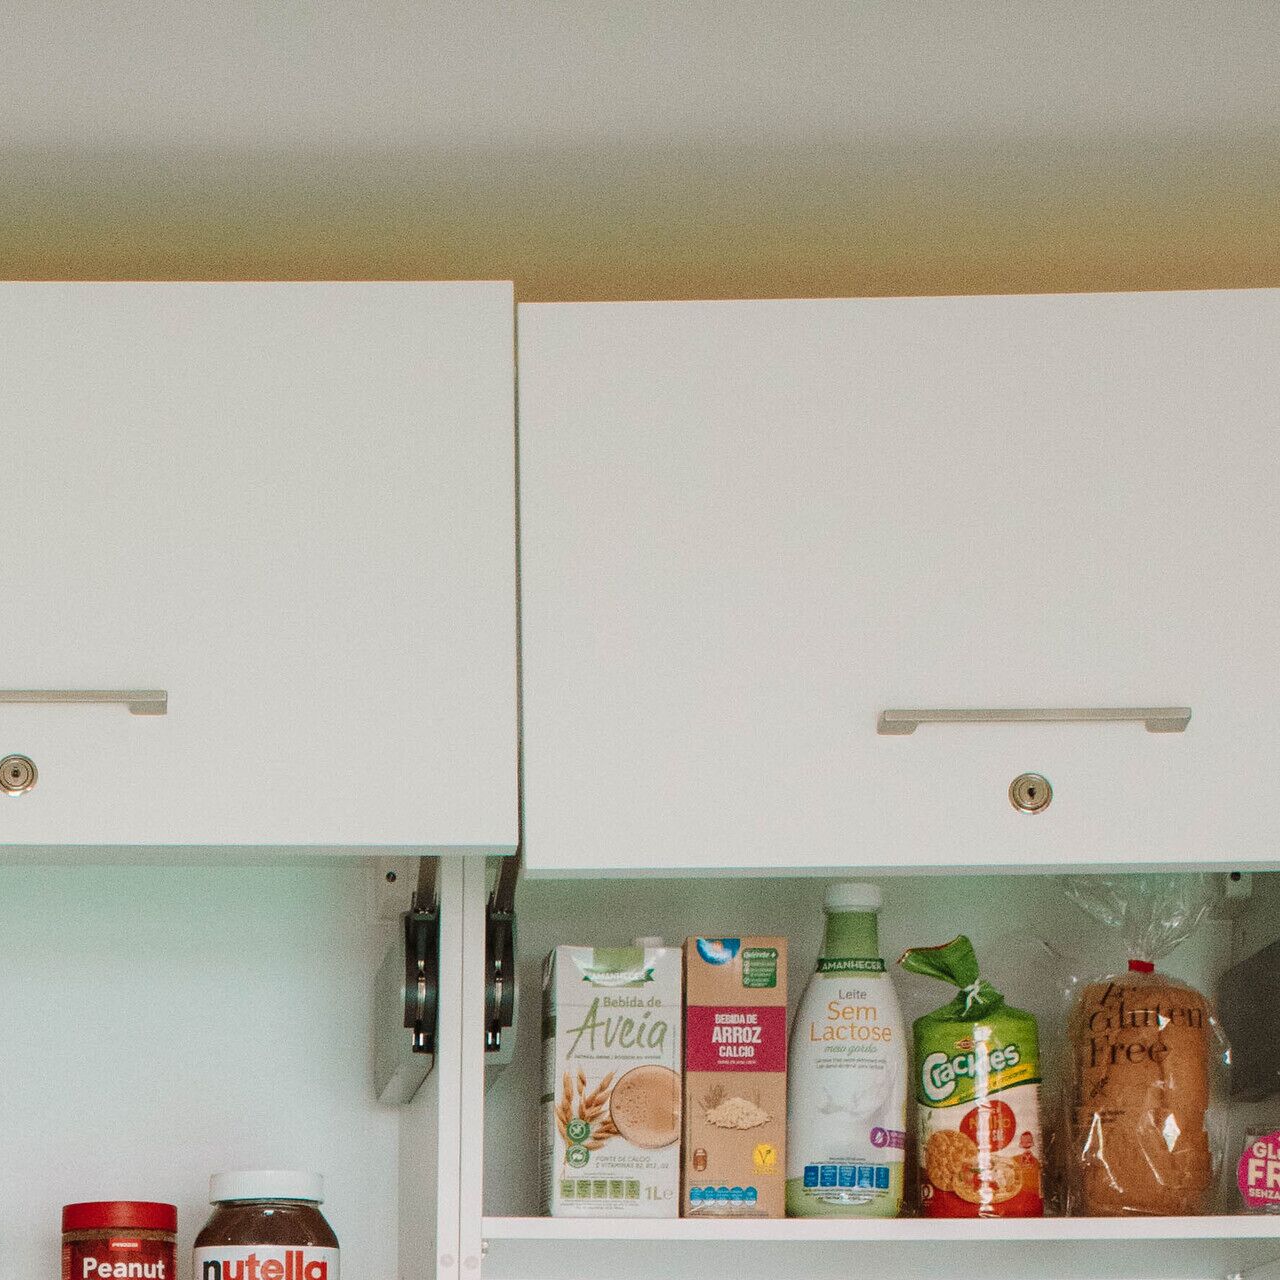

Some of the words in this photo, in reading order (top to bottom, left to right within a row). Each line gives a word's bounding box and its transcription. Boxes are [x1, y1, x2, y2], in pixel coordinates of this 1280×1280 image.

[603, 996, 644, 1008] Bebida
[647, 996, 662, 1008] de
[838, 989, 867, 1000] Leite
[714, 1013, 745, 1025] BEBIDA
[745, 1013, 758, 1025] DE
[827, 1000, 878, 1021] Sem
[1088, 1000, 1202, 1033] Gluten
[566, 996, 668, 1060] Aveia
[711, 1026, 762, 1044] ARROZ
[809, 1022, 892, 1042] Lactose
[718, 1045, 755, 1058] CALCIO
[1090, 1034, 1168, 1067] Free
[82, 1257, 166, 1280] Peanut
